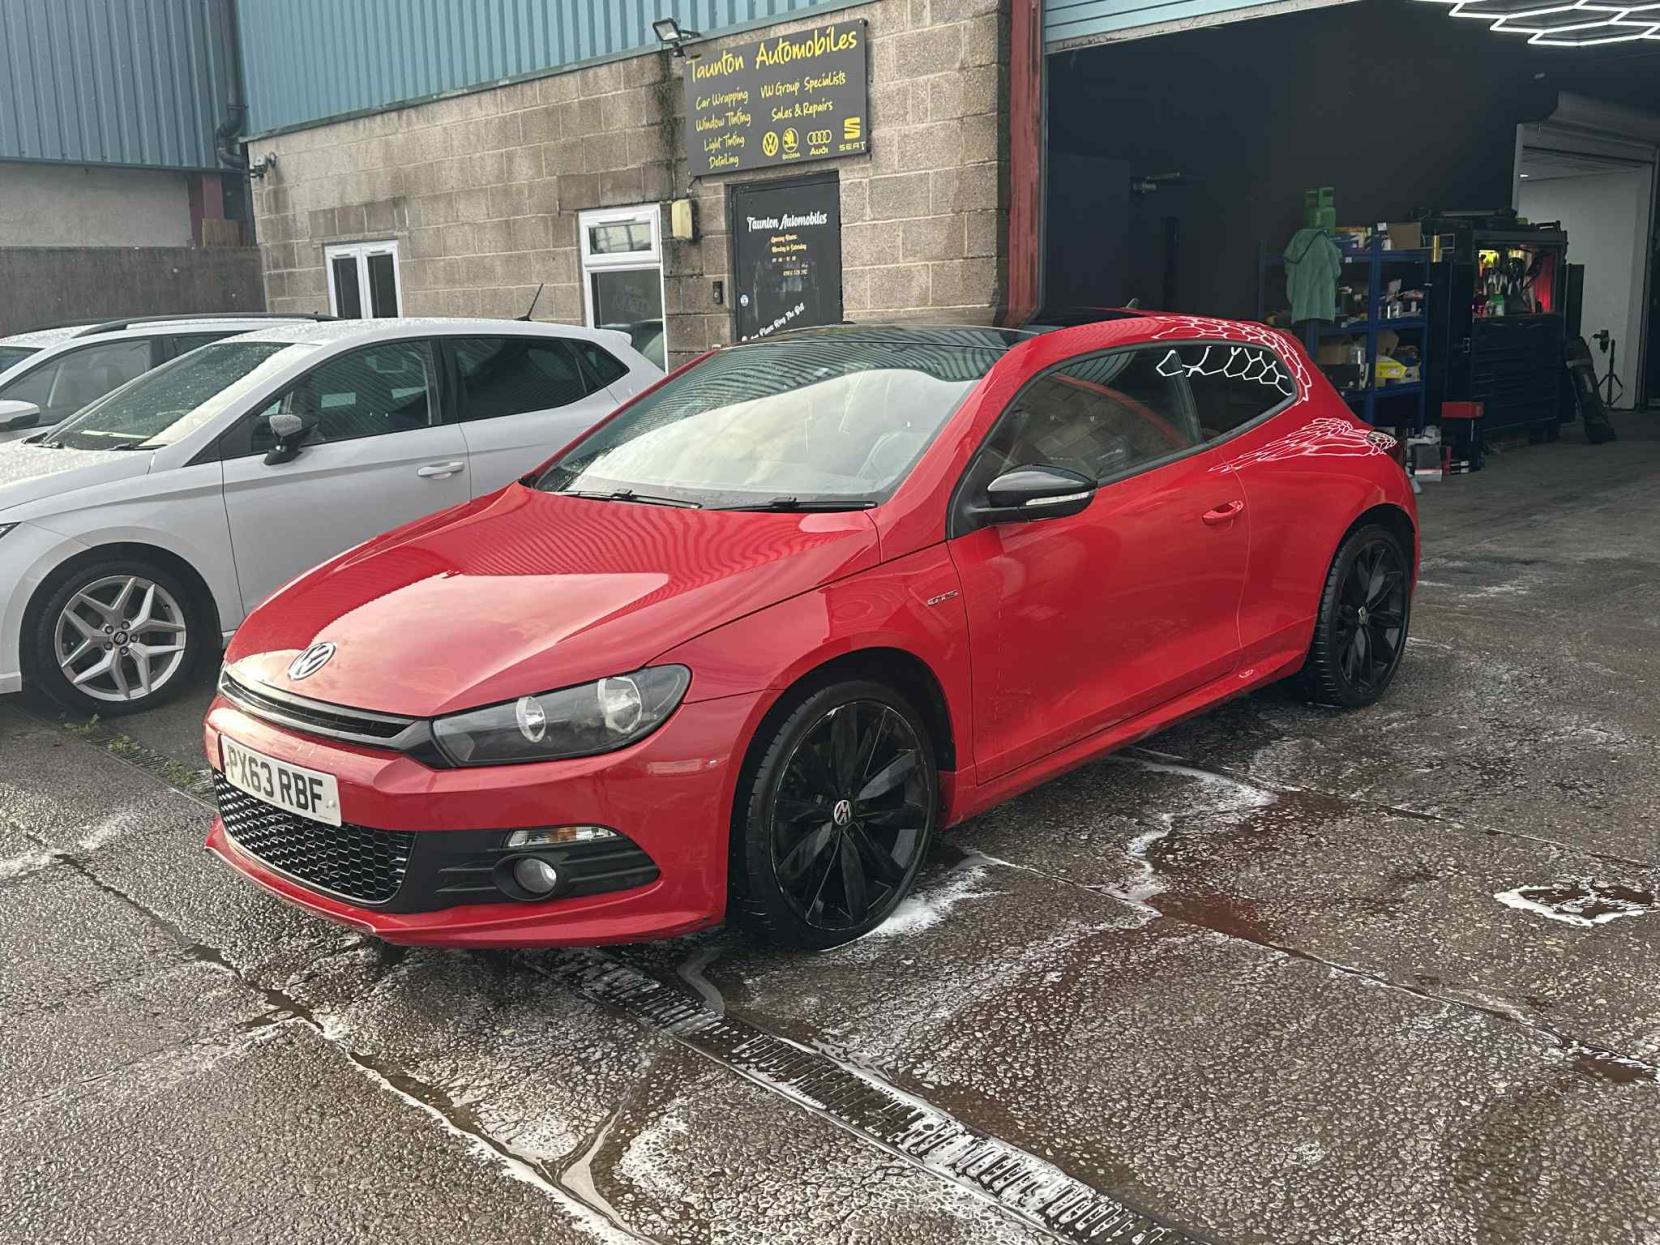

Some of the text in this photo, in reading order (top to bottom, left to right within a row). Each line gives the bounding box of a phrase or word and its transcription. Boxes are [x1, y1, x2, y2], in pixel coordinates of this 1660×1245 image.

[686, 26, 857, 83] Taunton Automobiles
[760, 70, 846, 99] VW Group Specialists
[696, 86, 748, 110] Car Wrapping
[771, 98, 833, 122] Sales & Repairs
[695, 107, 751, 132] Window Tinting
[704, 131, 745, 153] Light Tinting
[809, 145, 829, 156] Audi
[839, 140, 866, 152] SEAT
[709, 152, 739, 169] Detailing
[746, 210, 828, 232] Taunton Automobiles
[226, 744, 324, 814] PX63 RBF
